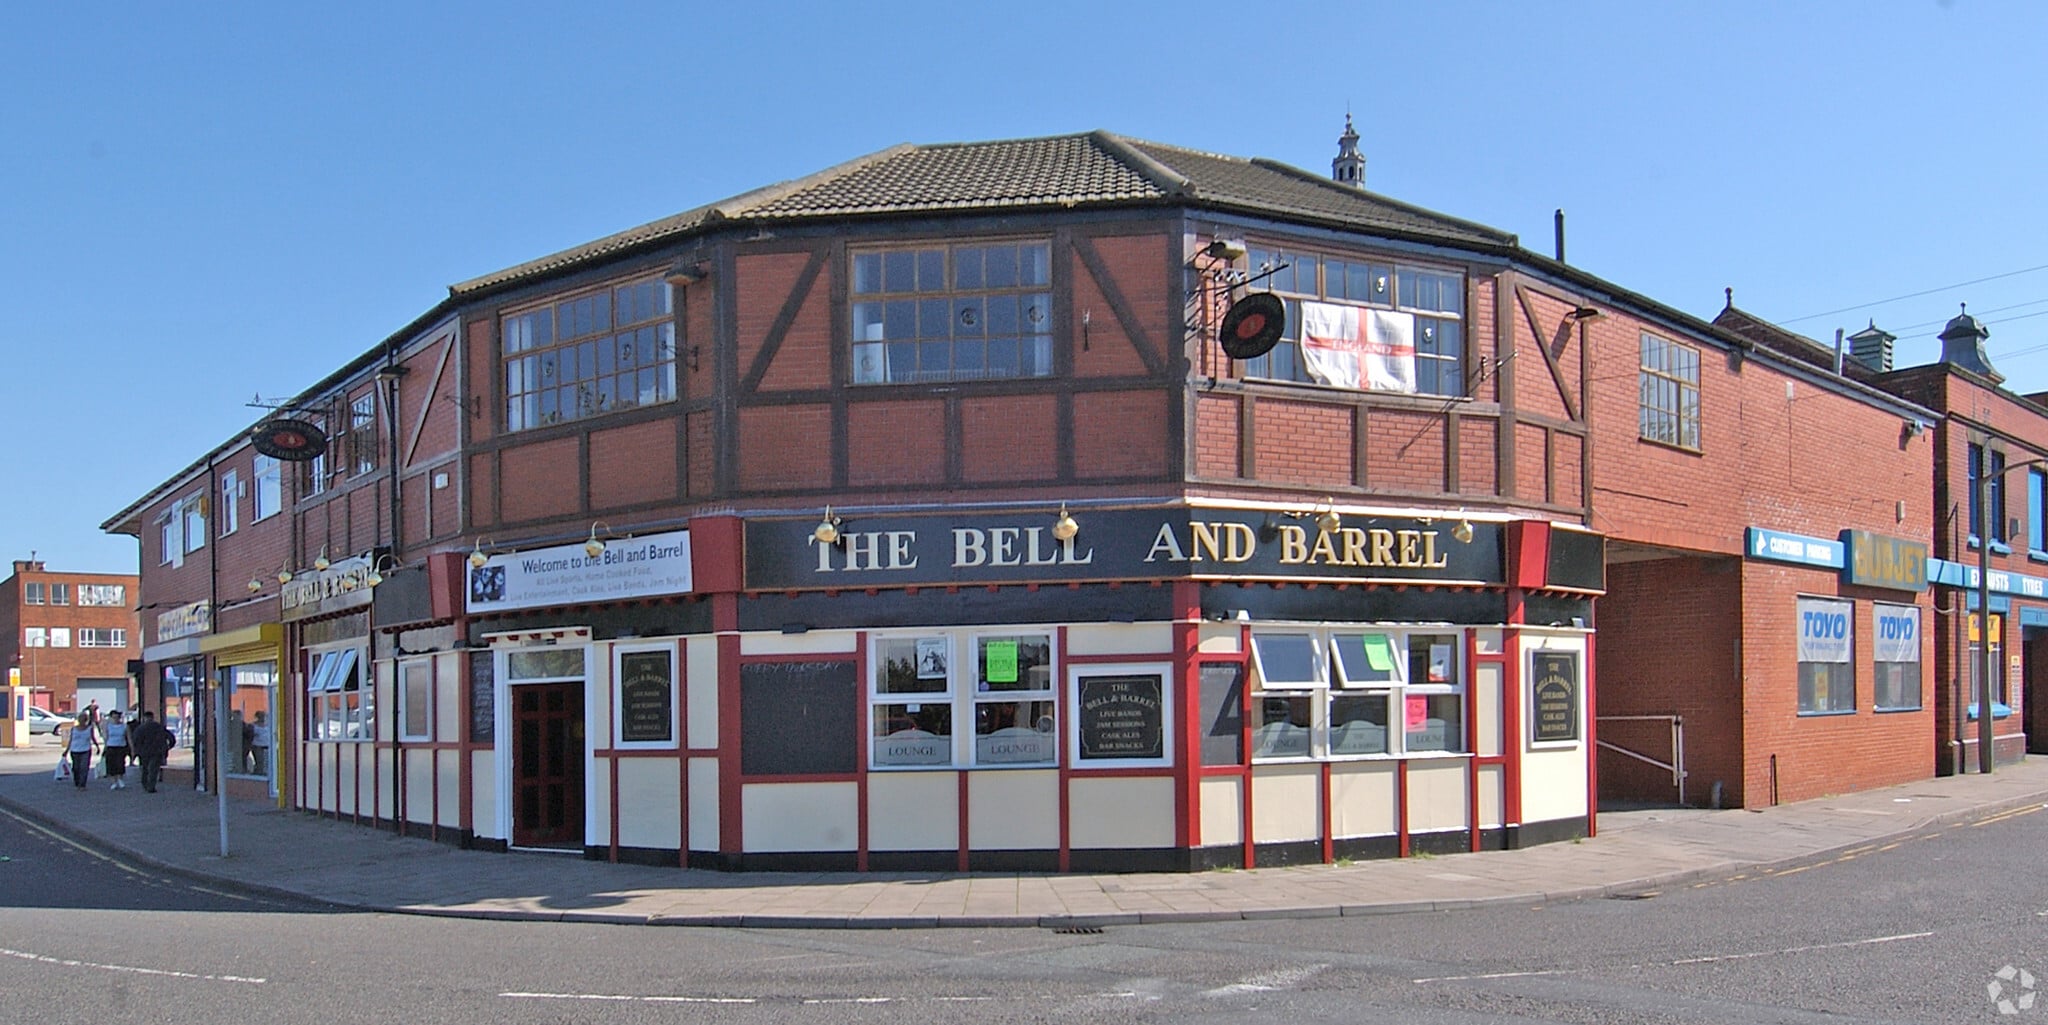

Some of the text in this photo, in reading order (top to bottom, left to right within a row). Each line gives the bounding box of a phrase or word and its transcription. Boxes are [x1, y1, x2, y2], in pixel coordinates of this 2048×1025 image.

[1332, 340, 1392, 354] ENGLAND
[808, 521, 1448, 572] THE BELL AND BARREL
[522, 558, 568, 574] Welcome
[571, 557, 582, 569] to
[604, 548, 624, 565] Bell
[626, 546, 646, 562] and
[649, 541, 683, 560] Barrel
[1803, 610, 1847, 640] TOYO
[1880, 615, 1914, 640] TOYO
[1112, 683, 1129, 692] THE
[1086, 694, 1156, 711] BELL & BARREL
[888, 746, 937, 757] LOUNGE
[990, 743, 1041, 755] LOUNGE
